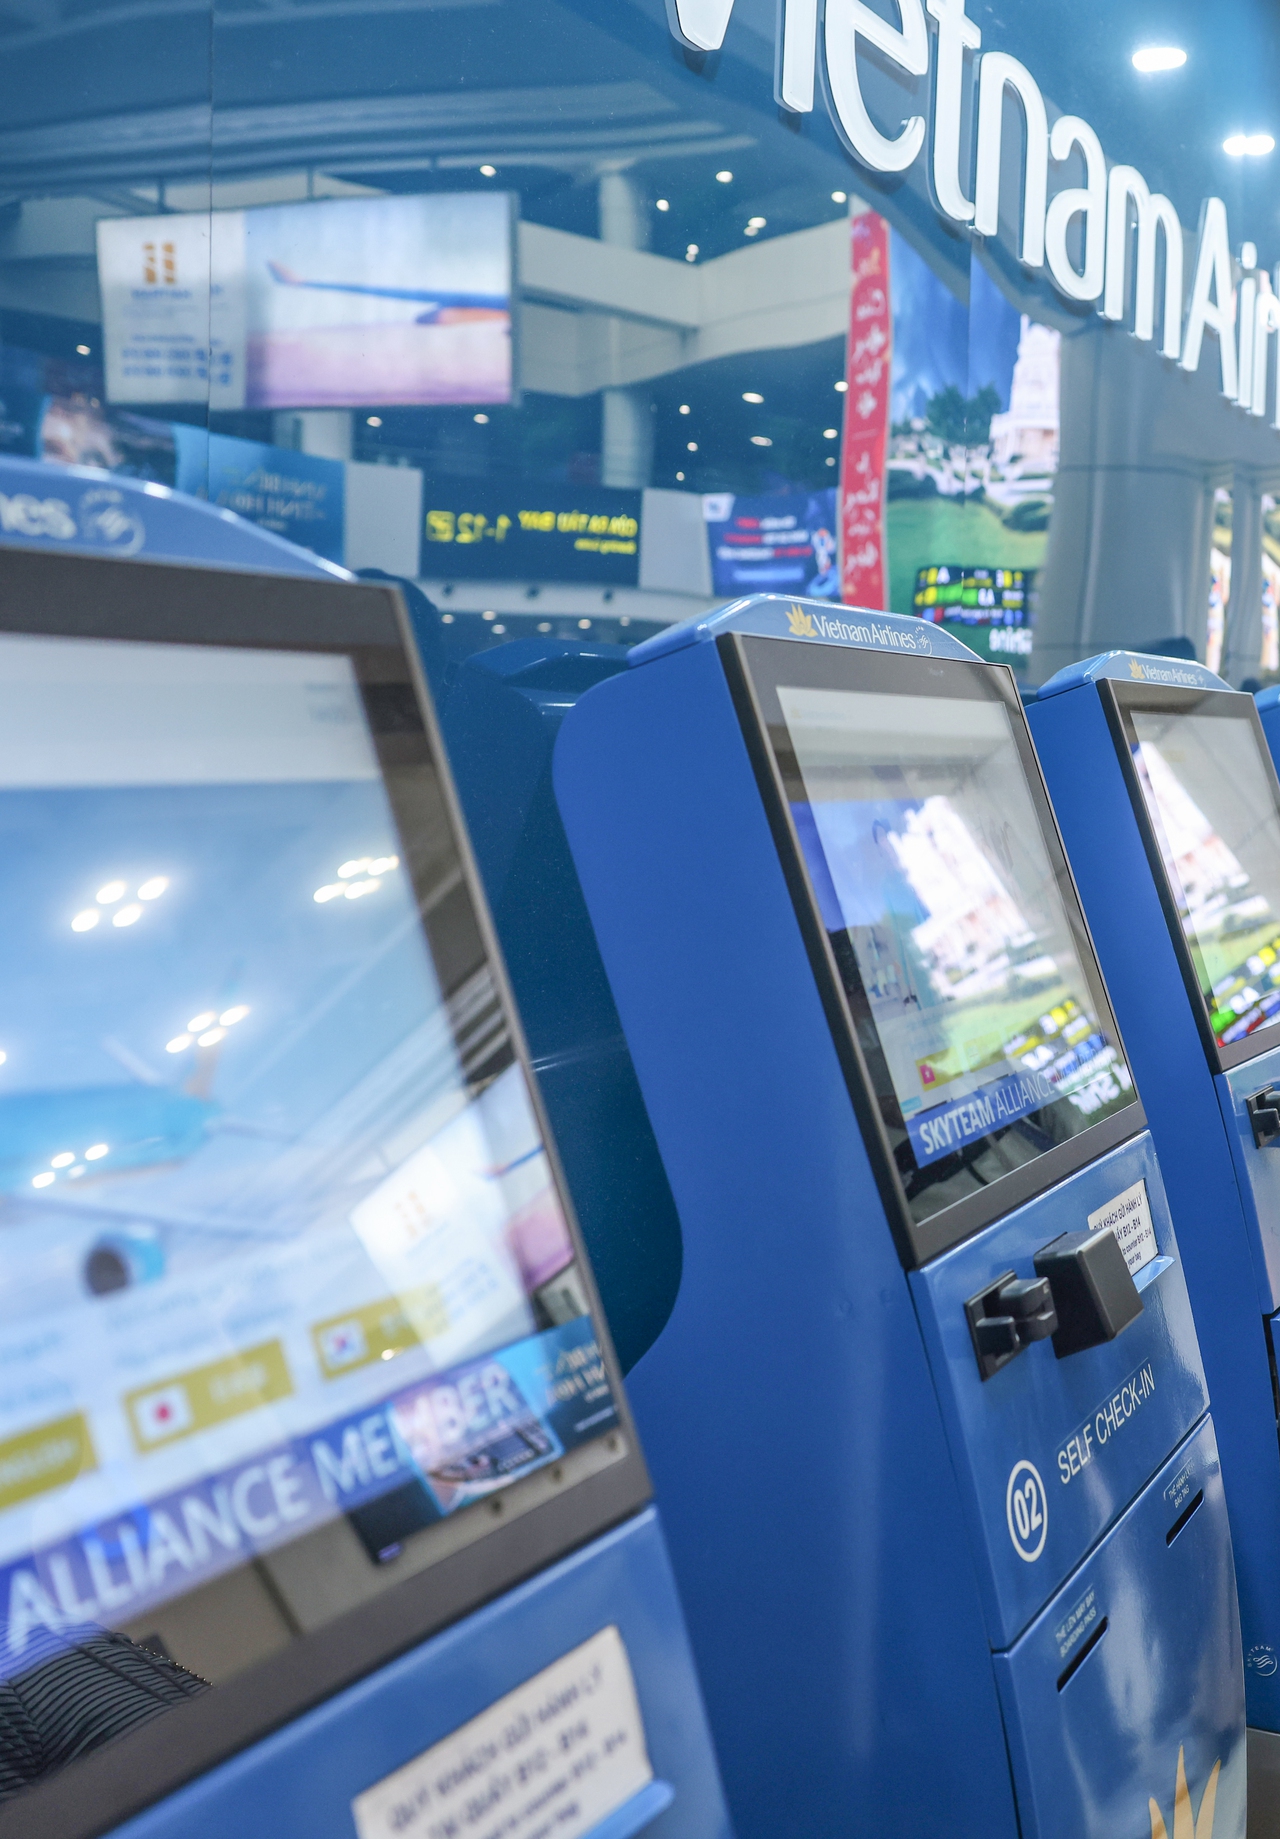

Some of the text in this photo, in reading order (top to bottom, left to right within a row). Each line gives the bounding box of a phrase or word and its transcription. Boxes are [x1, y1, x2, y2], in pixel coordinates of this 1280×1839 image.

[919, 1071, 1056, 1155] SKYTEAM ALLIANCE
[1057, 1363, 1155, 1484] SELF CHECK-IN
[4, 1453, 303, 1657] ALLIANCE
[1014, 1478, 1043, 1540] 02
